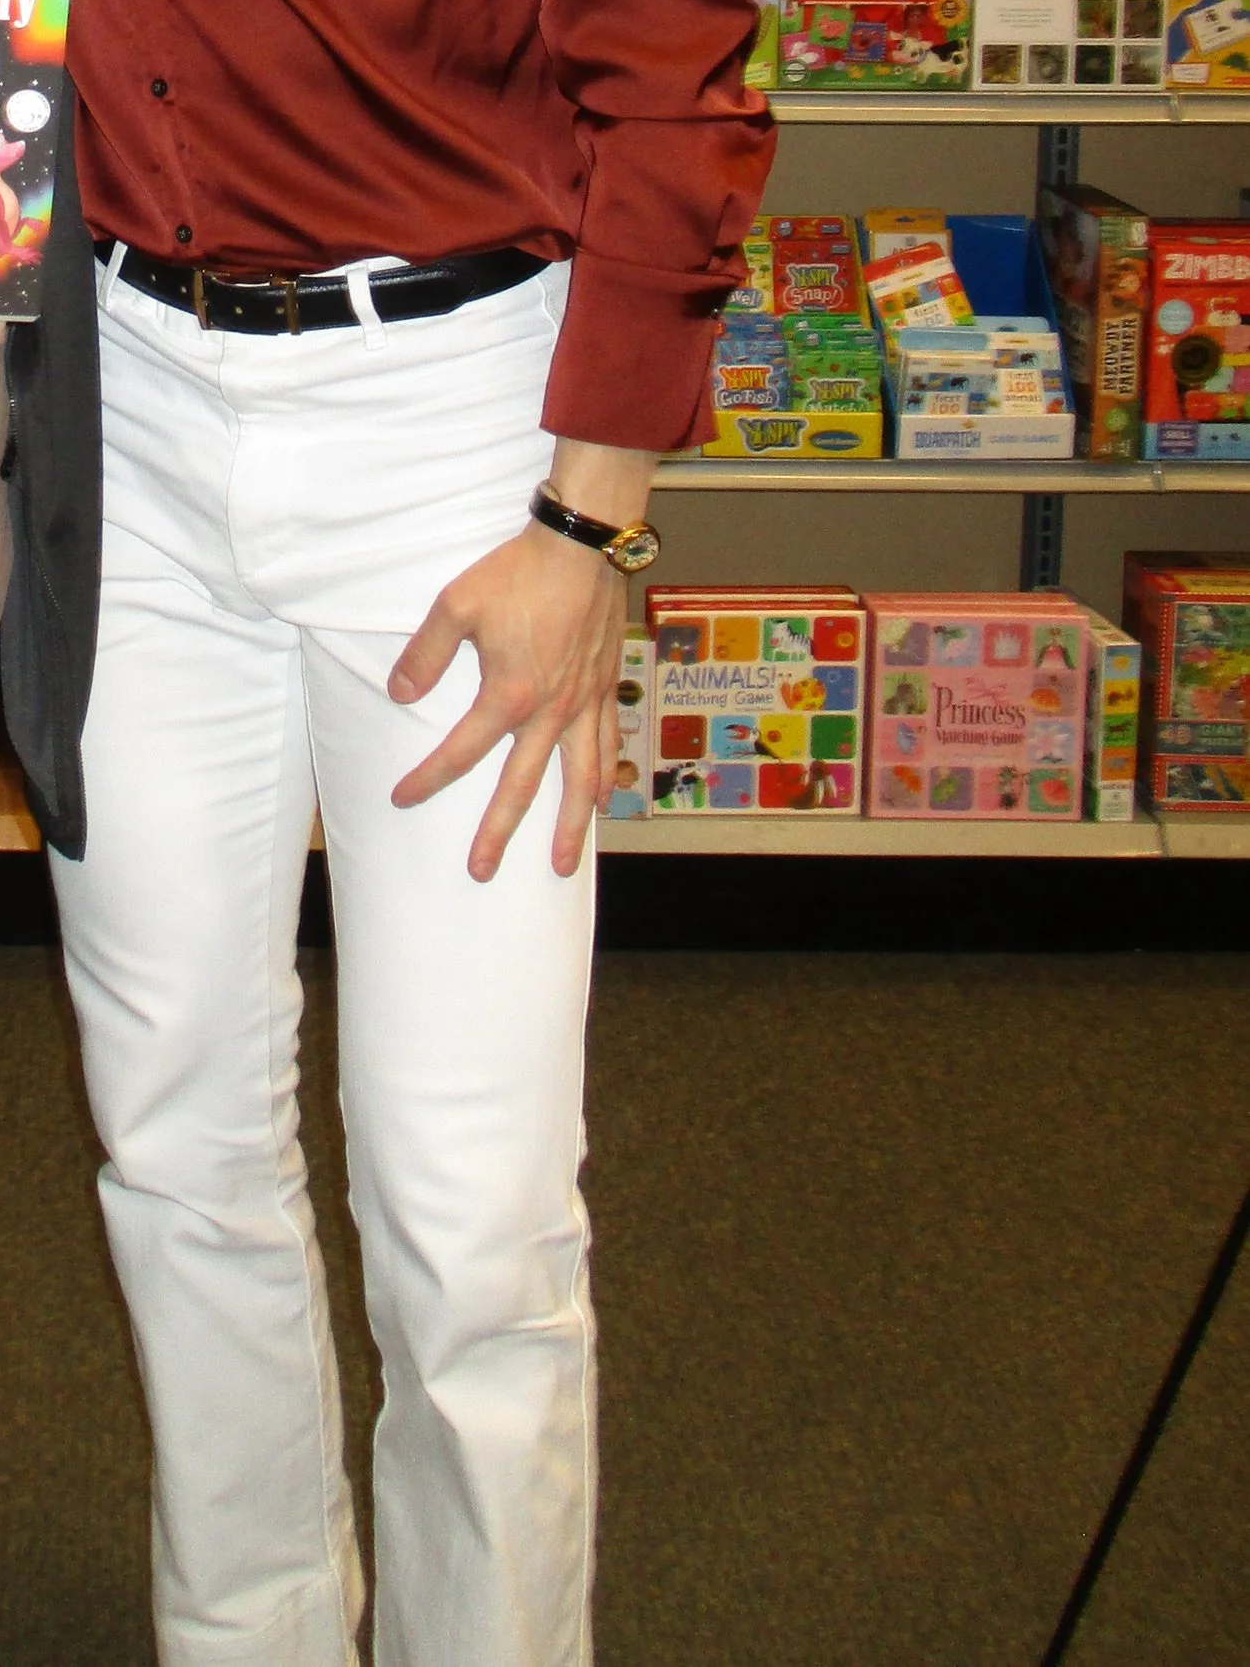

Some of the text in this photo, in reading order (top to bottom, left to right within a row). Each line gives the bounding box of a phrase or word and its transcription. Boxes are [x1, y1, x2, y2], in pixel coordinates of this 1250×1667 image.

[790, 287, 837, 305] Snap!
[664, 665, 776, 690] ANIMALS!
[664, 690, 775, 708] Matching Game
[931, 681, 1026, 729] Princess
